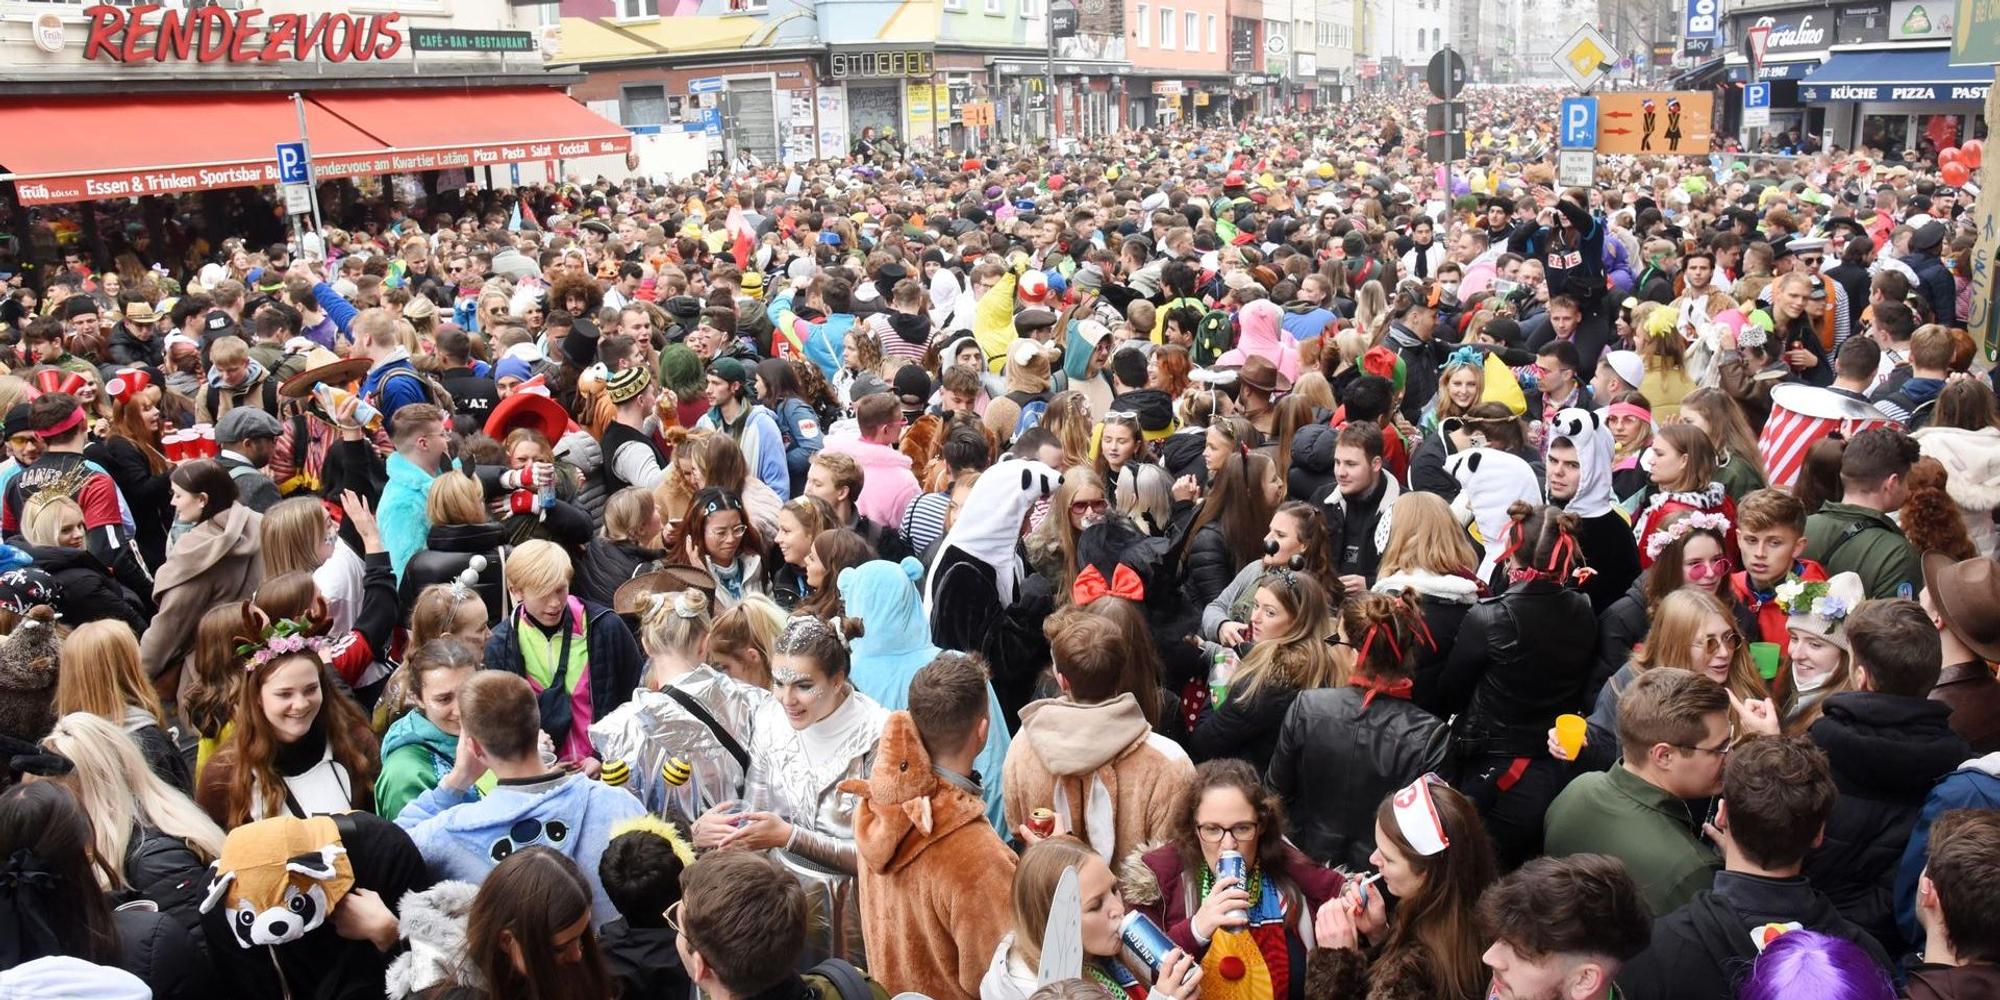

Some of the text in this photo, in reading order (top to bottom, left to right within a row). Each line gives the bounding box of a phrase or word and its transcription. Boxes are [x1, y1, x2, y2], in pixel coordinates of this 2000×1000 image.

[83, 4, 403, 63] RENDEZVOUS
[420, 34, 528, 48] CAFÉ BAR RESTAURANT
[1687, 41, 1708, 50] sky
[834, 53, 934, 78] STIEFEL
[1750, 86, 1764, 105] P
[1831, 85, 1988, 99] KÜCHE PIZZA PAST
[1568, 104, 1588, 141] P
[86, 178, 129, 196] Essen
[132, 175, 143, 192] &
[147, 172, 197, 190] Trinken
[200, 168, 262, 187] Sportsbar
[316, 160, 371, 176] endezvous
[374, 160, 390, 171] am
[393, 153, 434, 169] Kwartier
[473, 149, 497, 161] Pizza
[502, 147, 526, 159] Pasta
[531, 145, 551, 157] Salat
[558, 141, 590, 155] Cocktail
[281, 148, 297, 178] P
[1125, 929, 1155, 965] ENERGY
